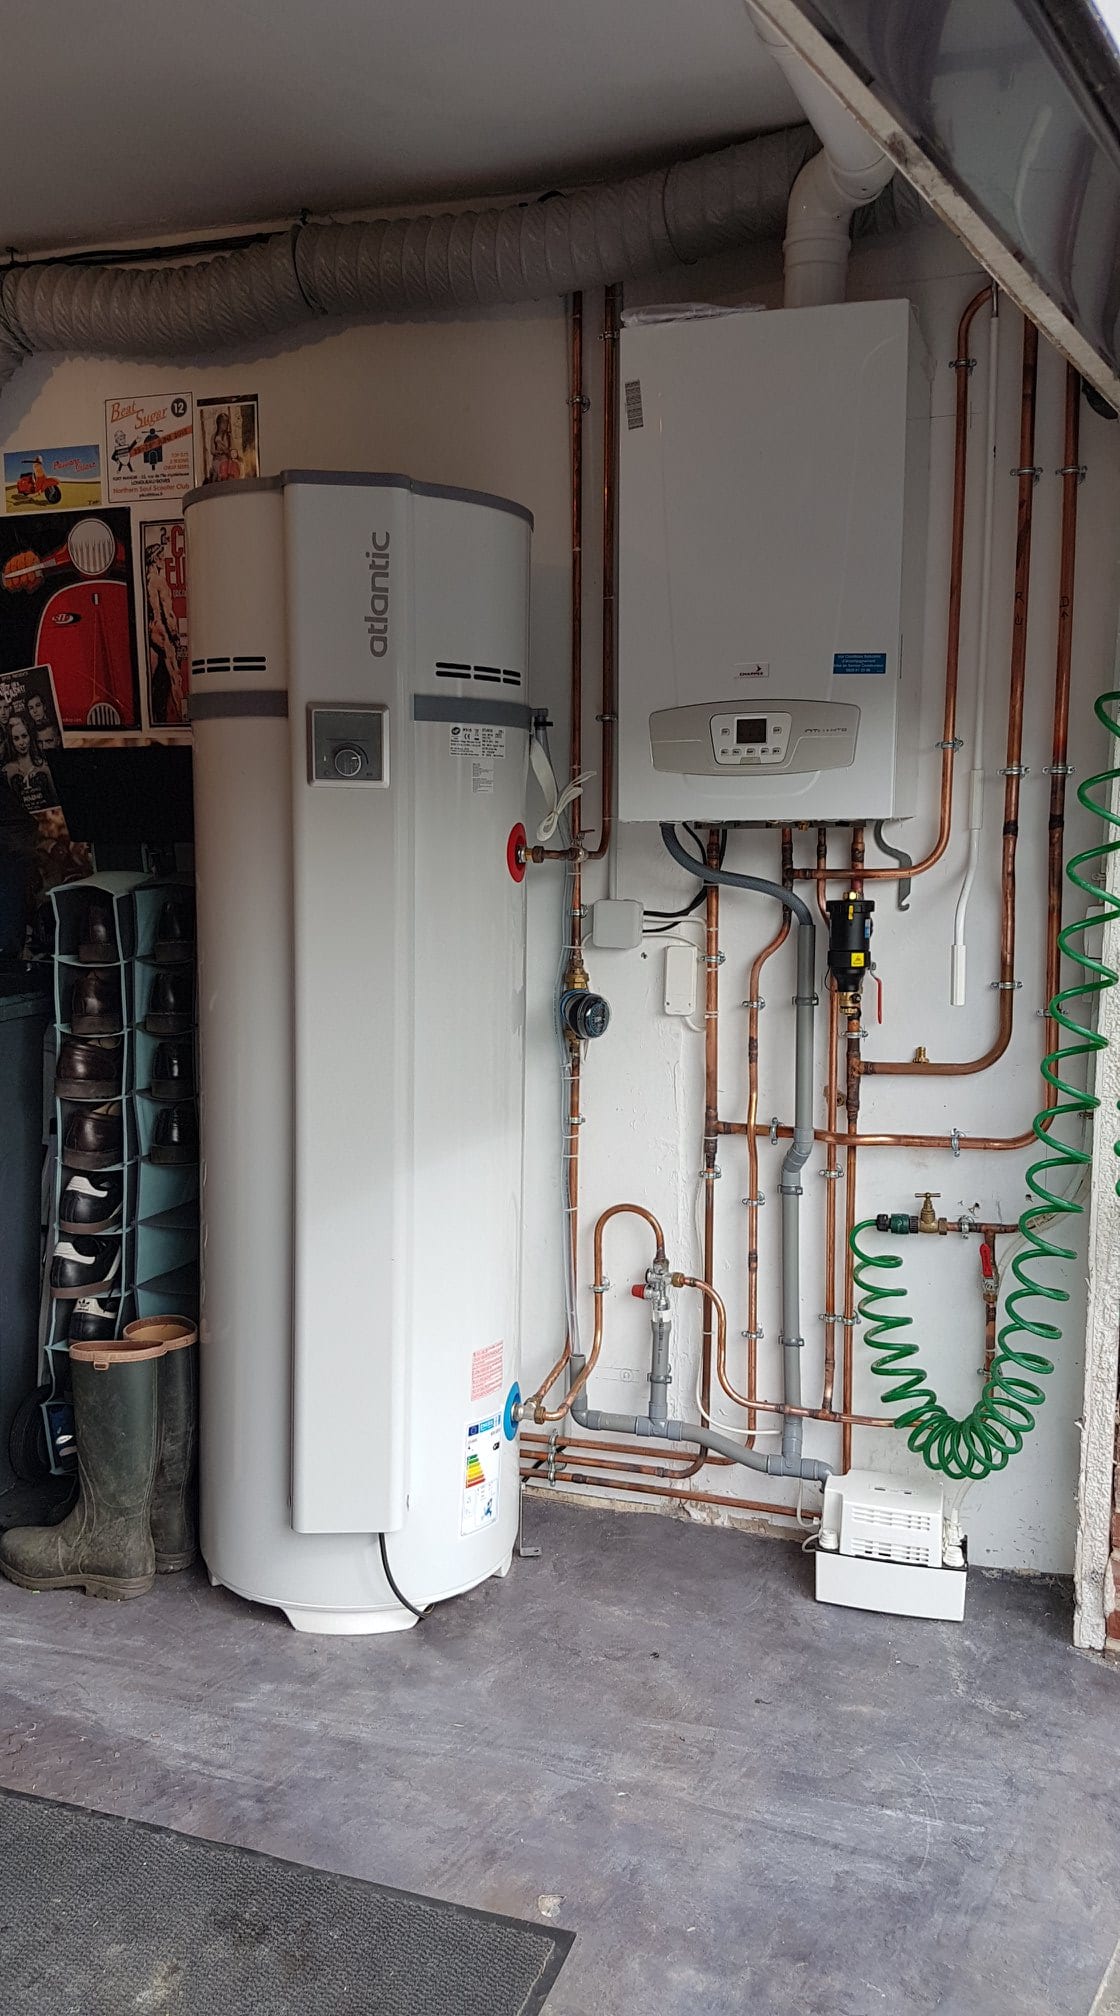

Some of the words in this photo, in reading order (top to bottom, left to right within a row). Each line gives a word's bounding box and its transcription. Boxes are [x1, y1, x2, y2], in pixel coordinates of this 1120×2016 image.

[111, 400, 137, 423] Beat
[173, 402, 185, 414] 12
[135, 408, 168, 429] Sugar
[176, 482, 190, 490] Club
[364, 531, 391, 658] atlantic
[1015, 591, 1025, 604] R
